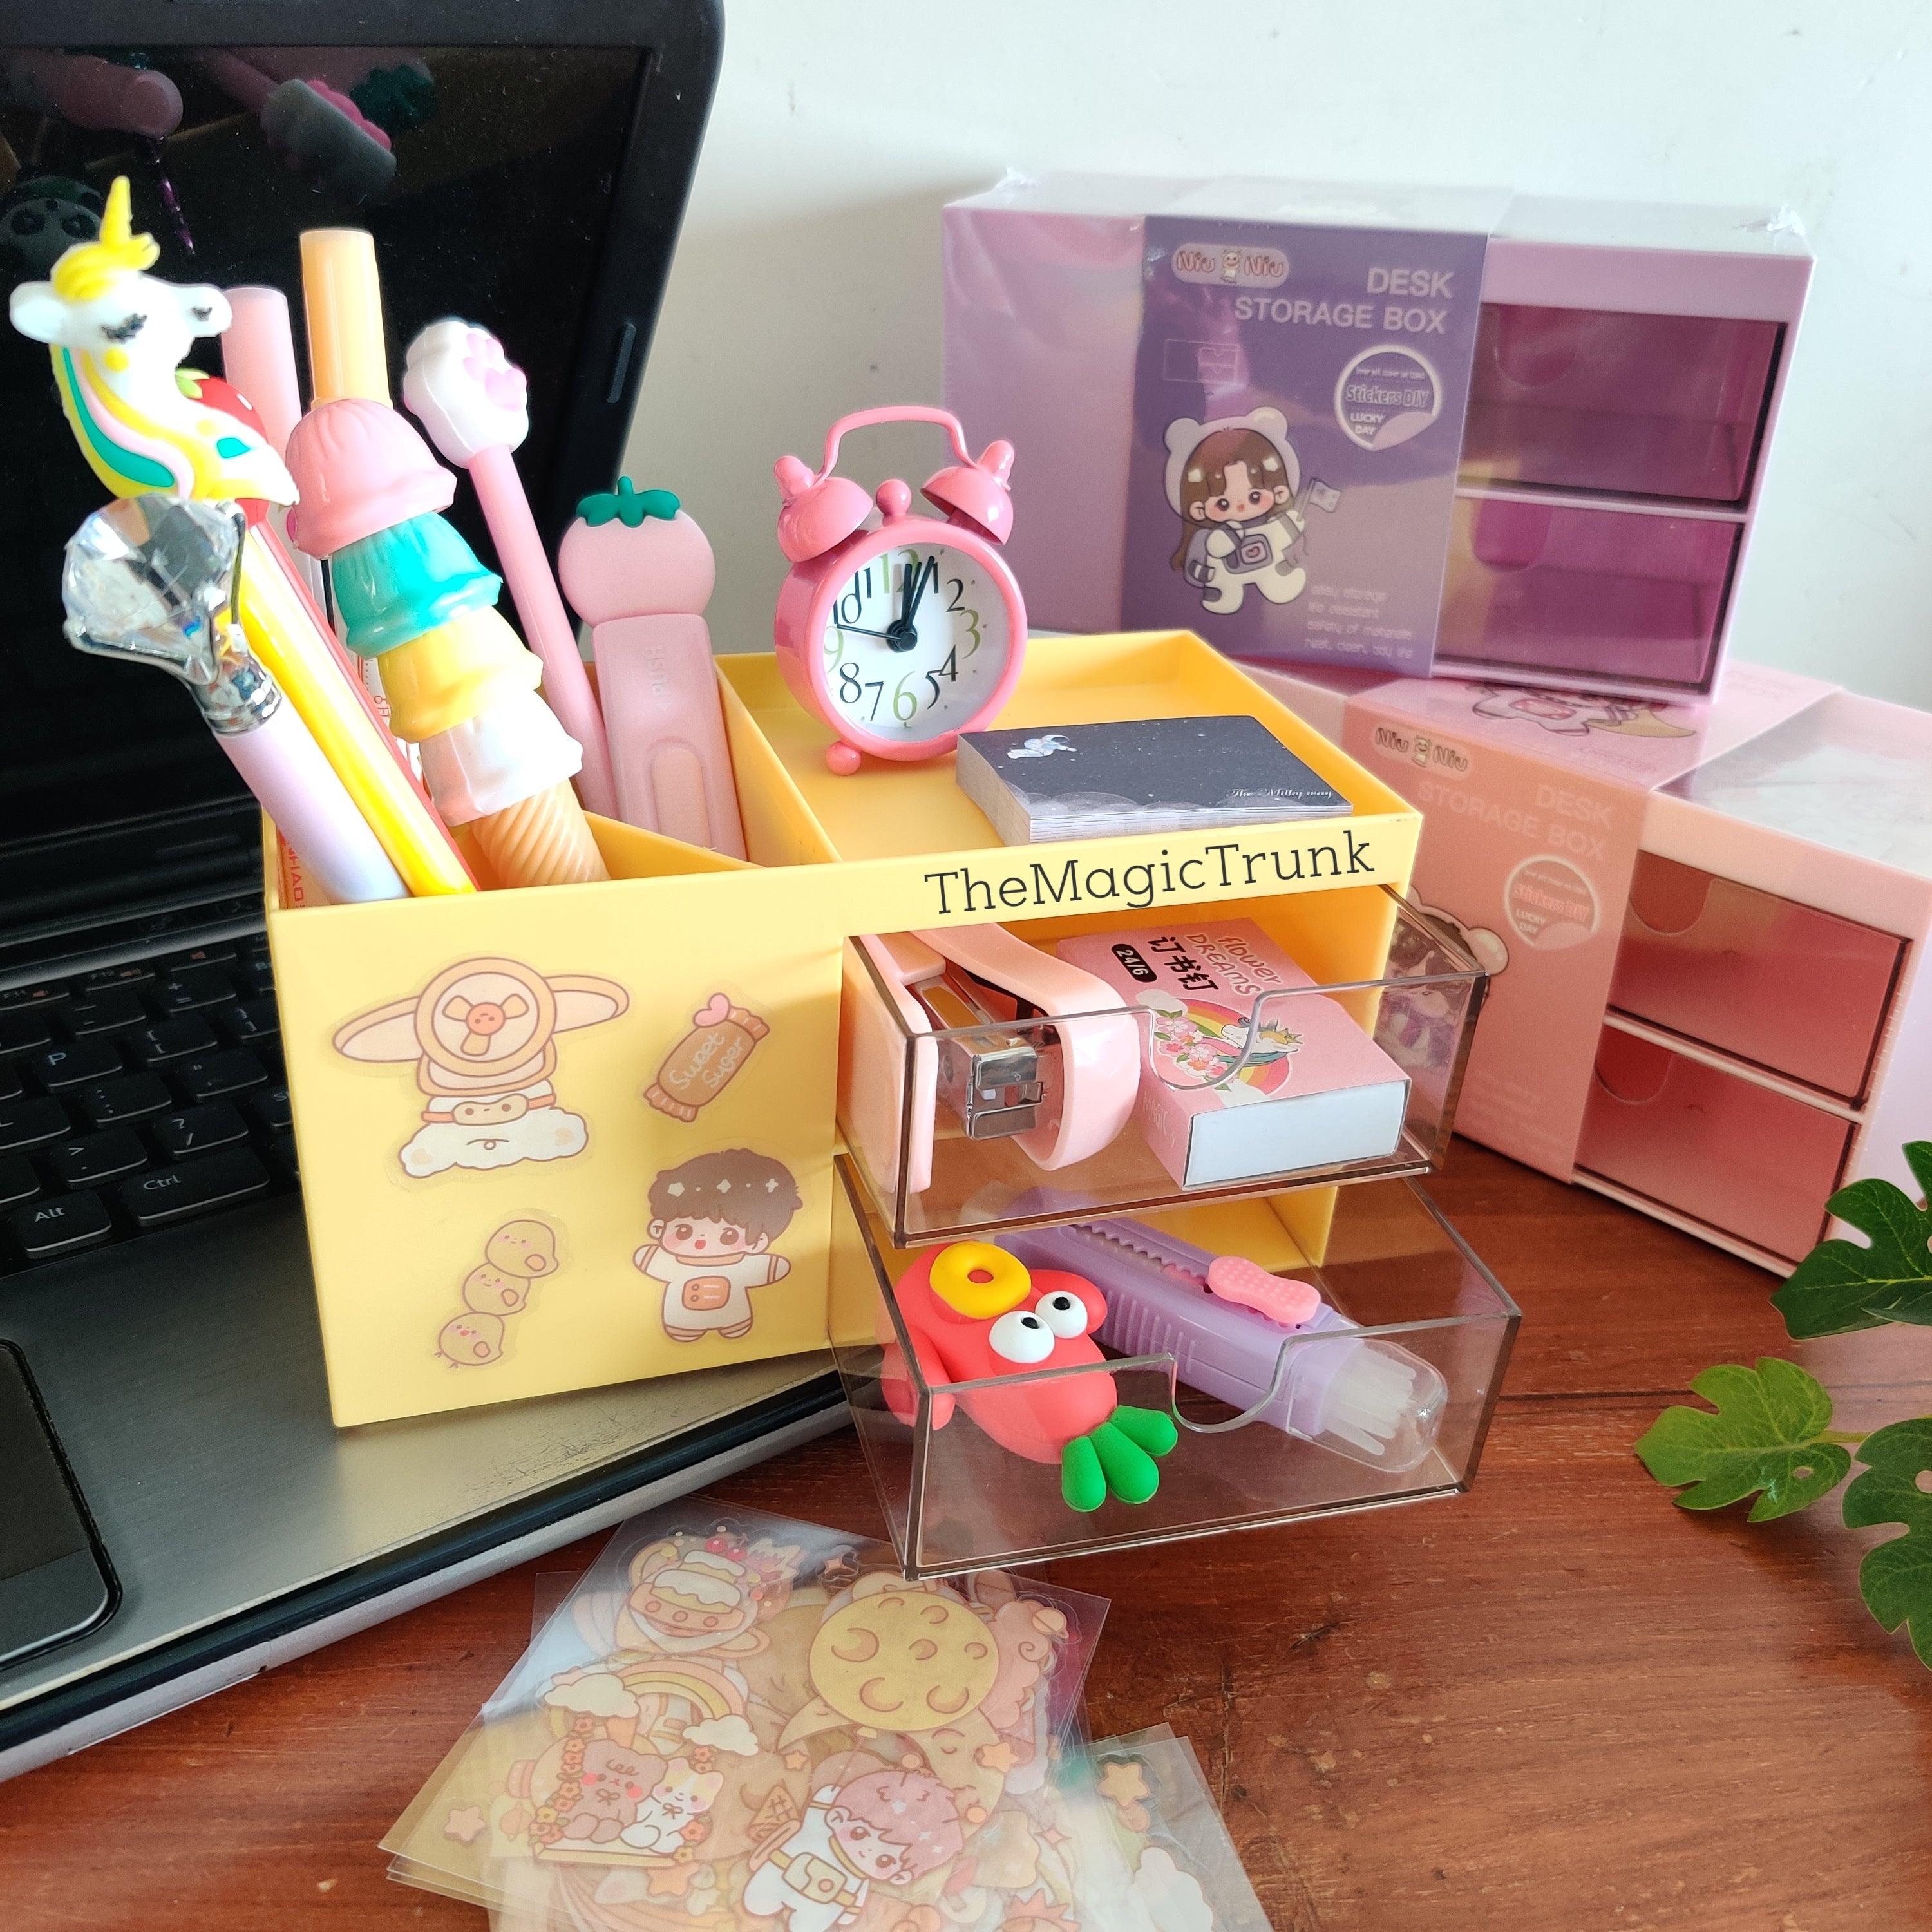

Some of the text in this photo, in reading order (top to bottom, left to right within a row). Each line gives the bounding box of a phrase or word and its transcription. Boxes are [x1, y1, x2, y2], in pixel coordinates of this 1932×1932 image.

[1176, 251, 1284, 278] Niu Niu
[1367, 267, 1454, 299] DESK
[1234, 297, 1446, 334] STORAGE BOX
[1345, 384, 1428, 408] Stickers DIY
[1350, 413, 1384, 423] LUCKY
[1355, 425, 1376, 435] DAY
[946, 578, 965, 612] 2
[824, 625, 844, 674] 9
[960, 609, 981, 659] 3
[938, 645, 959, 682] 4
[839, 662, 862, 703] 8
[893, 671, 917, 721] 6
[925, 670, 942, 710] 5
[864, 681, 885, 722] 7
[1376, 728, 1468, 772] Niu Niu
[1418, 780, 1607, 862] STORAGE BOX
[1534, 783, 1614, 830] DESK
[1115, 949, 1149, 976] 24/6
[1147, 936, 1219, 990] 订书钉
[47, 1052, 66, 1066] P
[669, 1032, 725, 1090] Sweet
[142, 1174, 182, 1191] Ctrl
[35, 1206, 65, 1222] Alt
